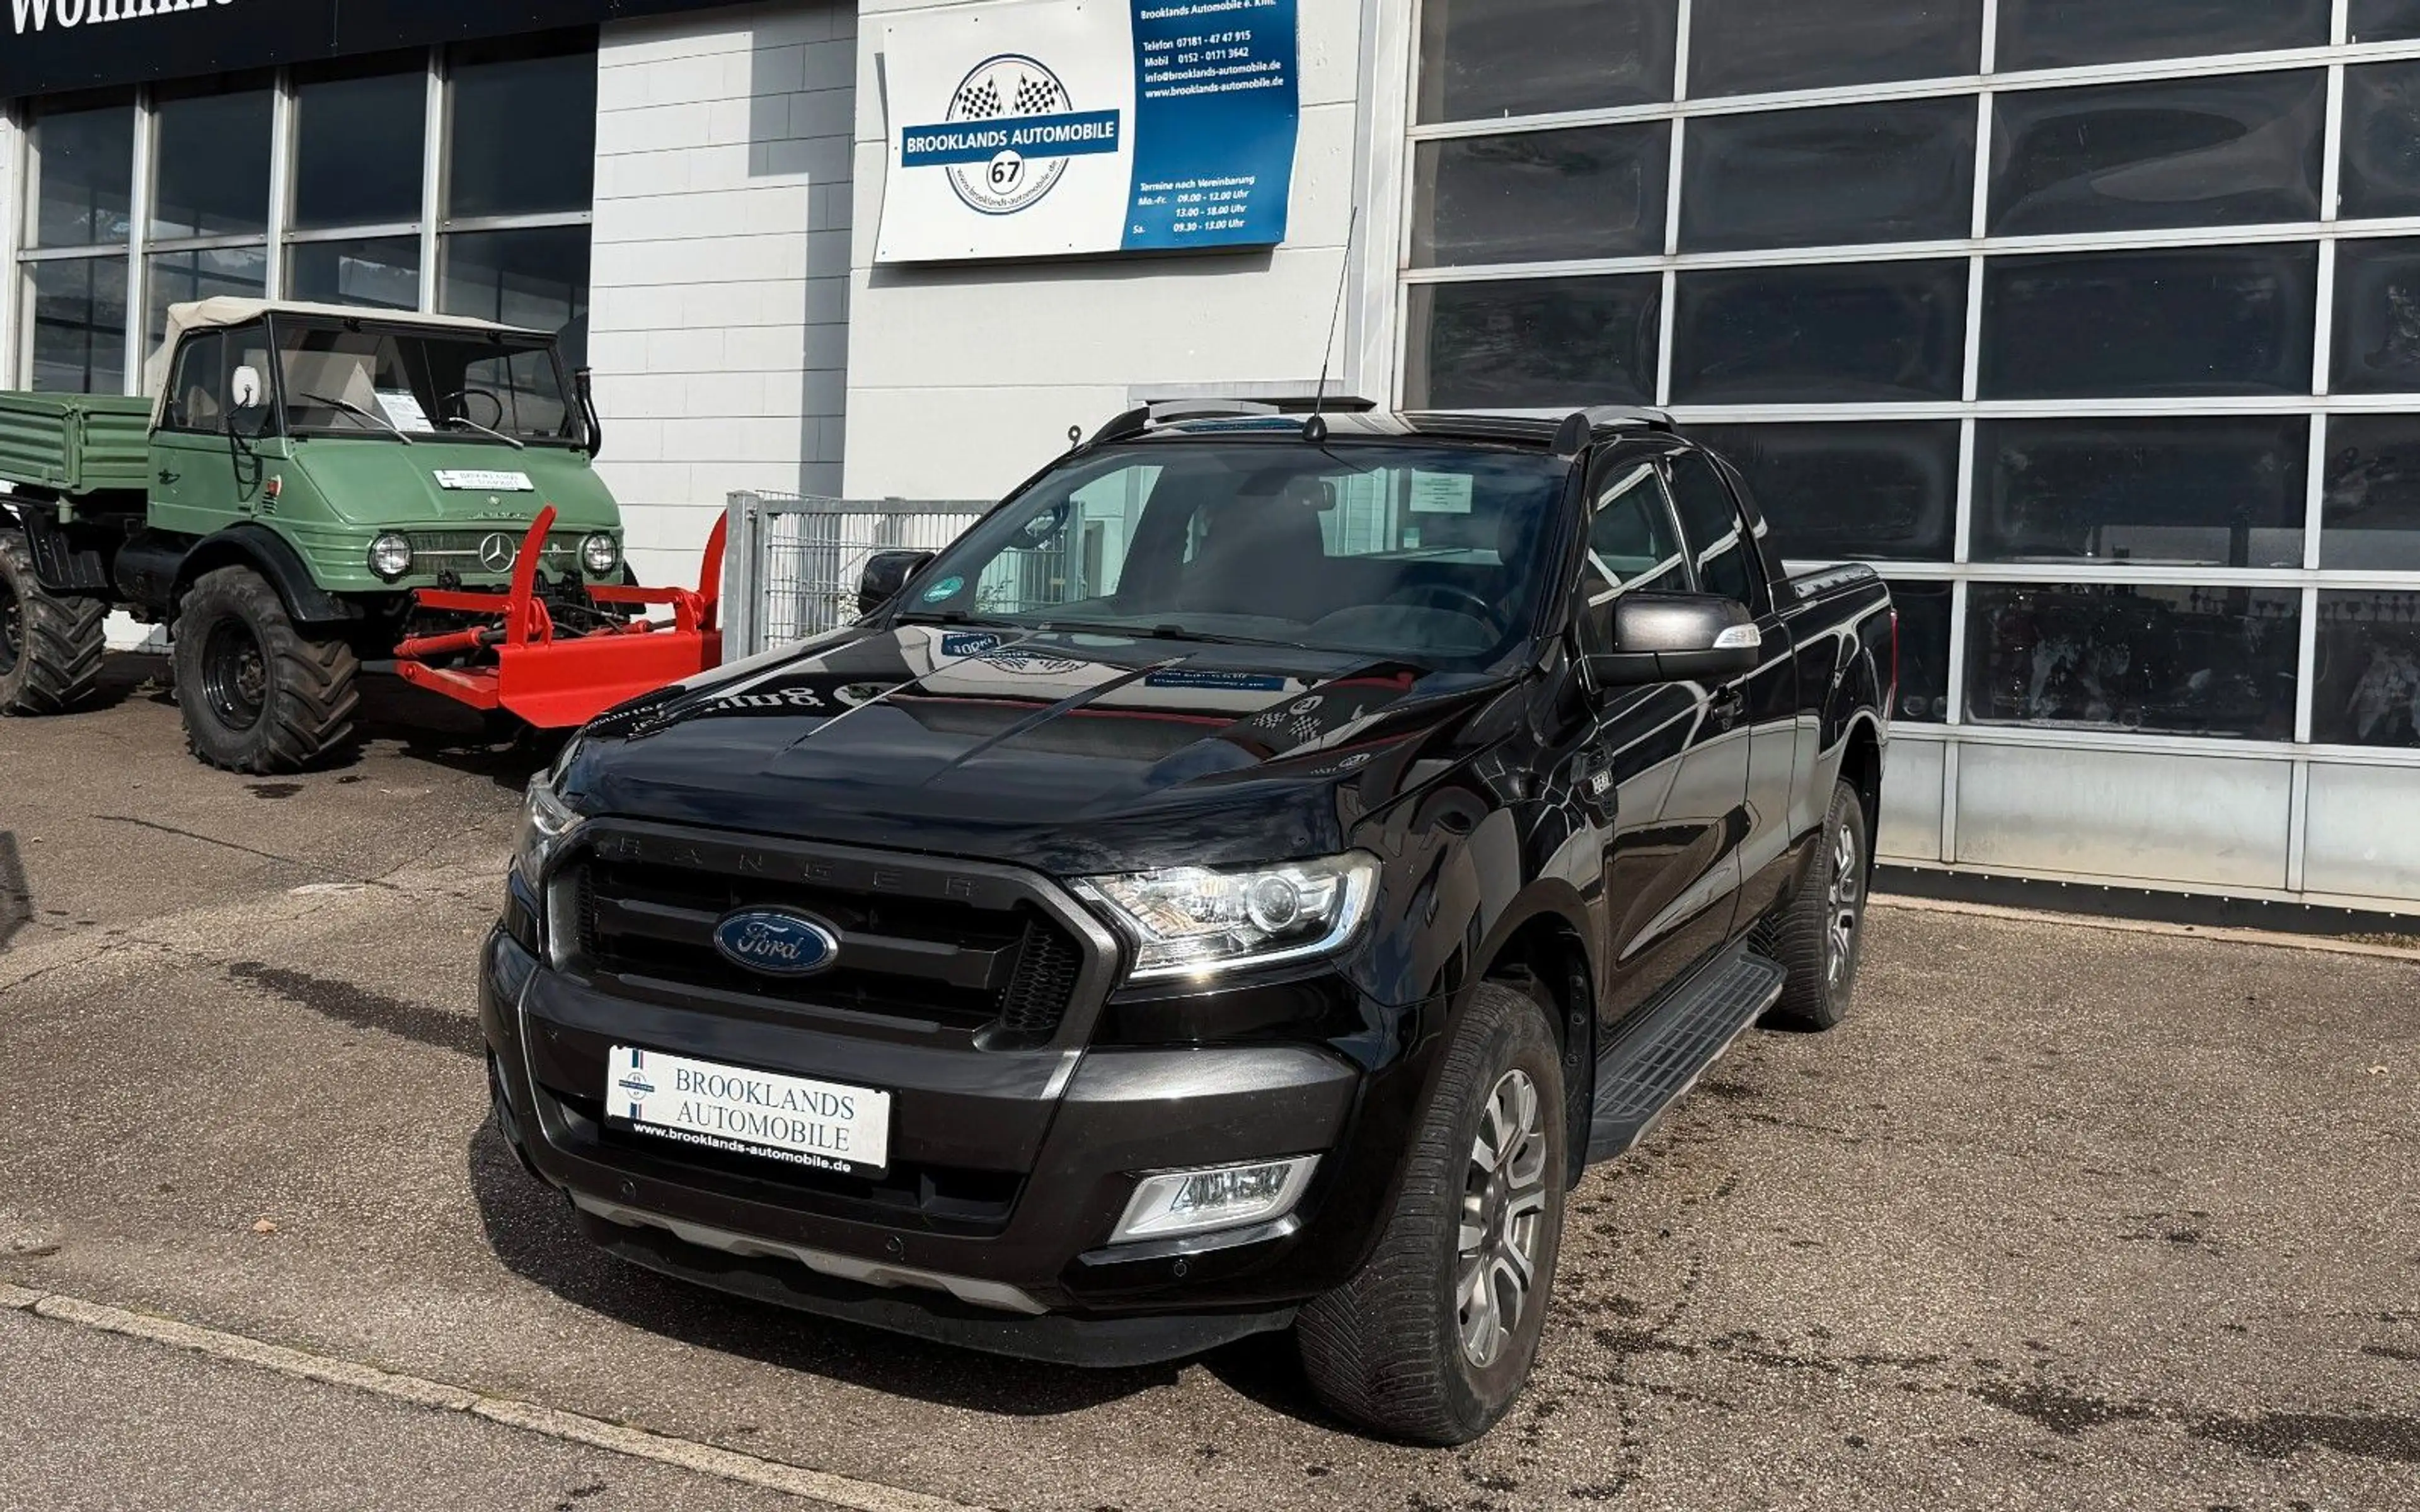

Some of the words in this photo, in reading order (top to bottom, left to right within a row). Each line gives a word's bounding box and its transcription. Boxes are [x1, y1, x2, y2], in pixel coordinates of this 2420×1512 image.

[1141, 8, 1189, 20] Brooklands
[1190, 1, 1242, 15] Automobile
[1143, 40, 1174, 51] Telefon
[1176, 36, 1202, 48] 07181
[1209, 34, 1220, 44] 47
[1222, 32, 1233, 42] 47
[1234, 30, 1252, 41] 915
[1144, 55, 1169, 67] Mobil
[1178, 52, 1199, 64] 0152
[1205, 50, 1226, 62] 0171
[1144, 59, 1281, 83] info@brooklands-automobile.de
[1144, 76, 1284, 98] www.brooklands-automobile.de
[906, 129, 1008, 154] BROOKLANDS
[1011, 120, 1115, 145] AUTOMOBILE
[991, 161, 1021, 184] 67
[1140, 181, 1174, 192] Termine
[1175, 179, 1196, 190] nach
[1197, 175, 1256, 188] Vereinbarung
[1233, 189, 1250, 199] Uhr
[1230, 204, 1248, 214] Uhr
[1228, 219, 1246, 229] Uhr
[619, 835, 972, 897] RANGER
[737, 921, 805, 960] Ford
[676, 1068, 855, 1120] BROOKLANDS
[676, 1100, 851, 1152] AUTOMOBILE
[633, 1121, 852, 1173] www.brooklands-automobile.de
